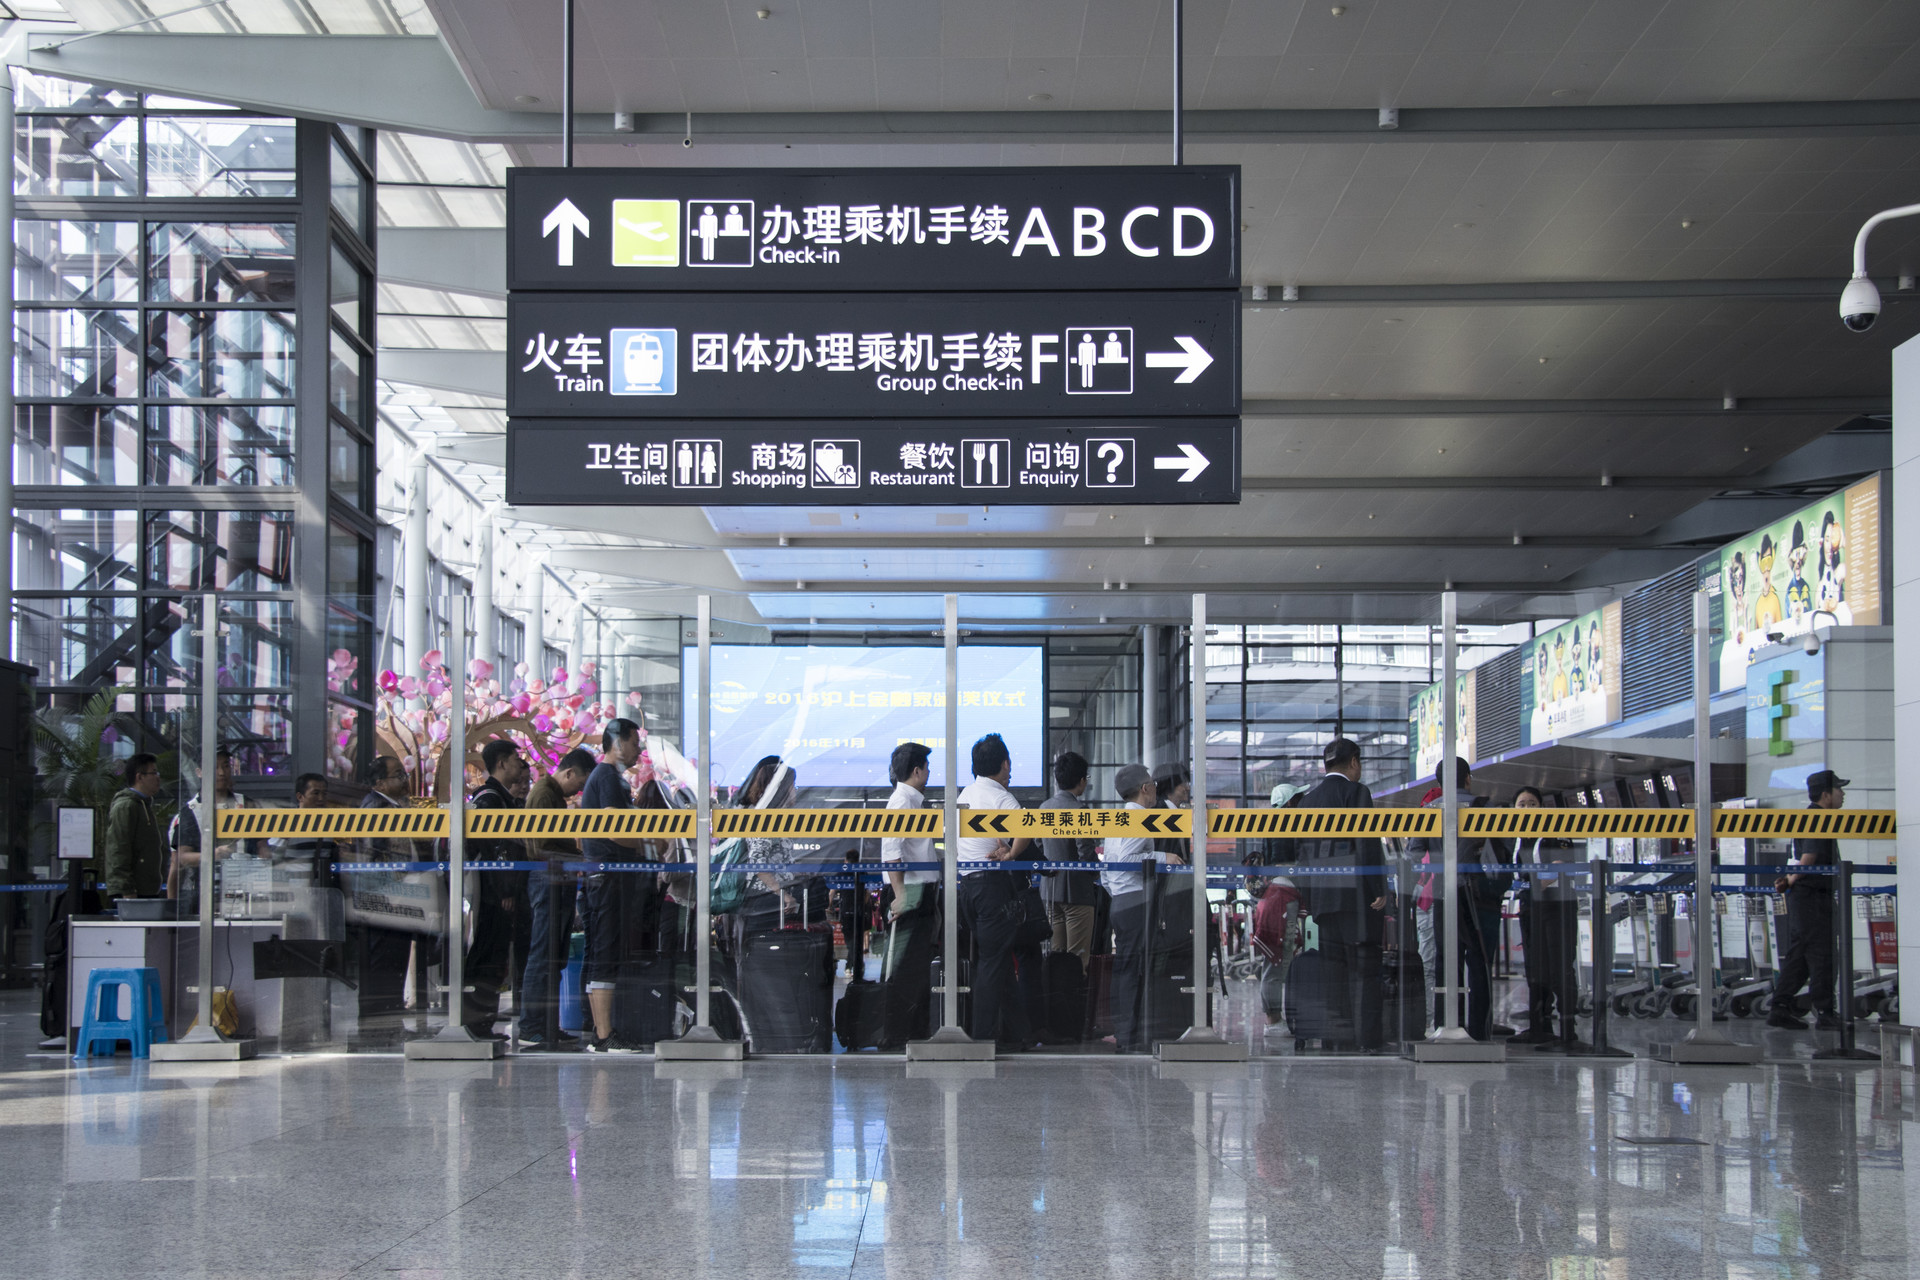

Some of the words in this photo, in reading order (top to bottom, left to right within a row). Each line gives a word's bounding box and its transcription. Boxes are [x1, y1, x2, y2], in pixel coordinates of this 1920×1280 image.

[762, 205, 1009, 244] 办理乘机手续
[759, 246, 839, 264] Check-in
[523, 333, 603, 373] 火车
[693, 332, 1022, 373] 团体办理乘机手续
[1032, 335, 1058, 383] F
[555, 375, 603, 391] Train
[877, 375, 936, 394] Group
[943, 374, 1022, 391] Check-in
[586, 443, 667, 470] 卫生间
[752, 443, 806, 470] 商场
[900, 443, 955, 470] 餐饮
[1027, 442, 1079, 469] 问询
[622, 471, 667, 485] Toilet
[732, 471, 806, 489] Shopping
[871, 472, 954, 486] Restaurant
[1020, 471, 1079, 488] Enquiry
[1022, 812, 1130, 827] 办理乘机手续
[1053, 828, 1099, 836] Check-in
